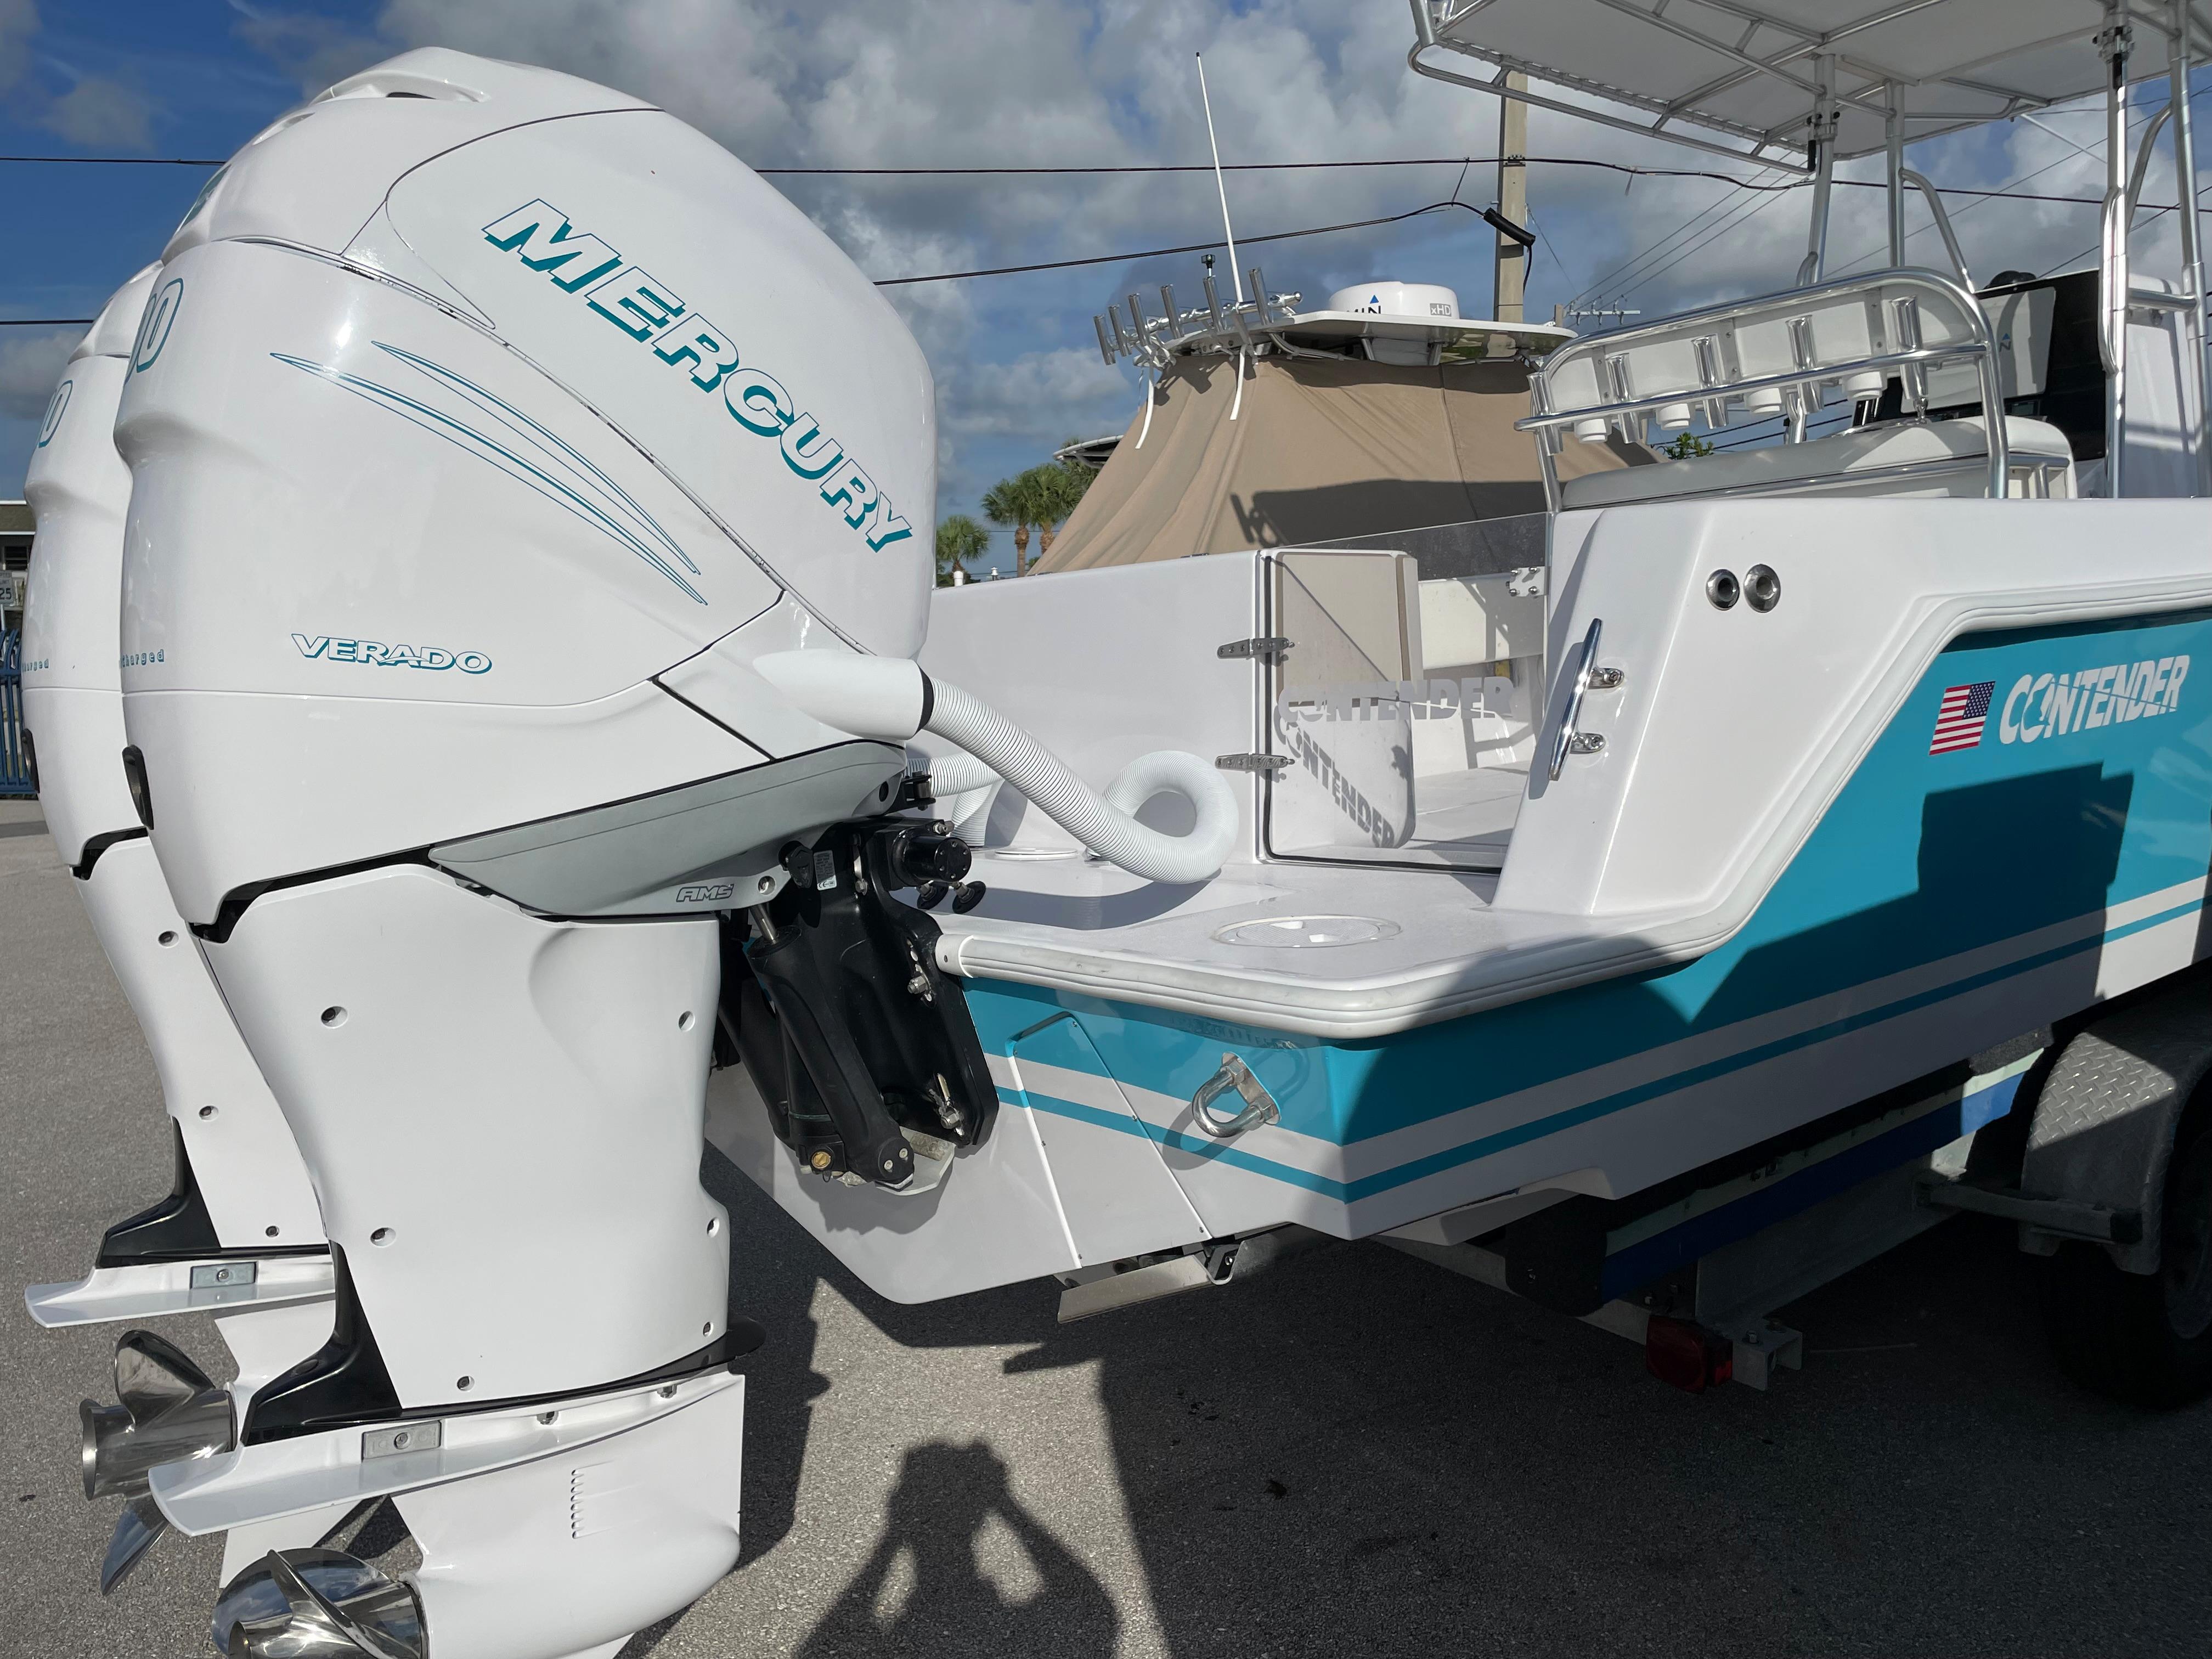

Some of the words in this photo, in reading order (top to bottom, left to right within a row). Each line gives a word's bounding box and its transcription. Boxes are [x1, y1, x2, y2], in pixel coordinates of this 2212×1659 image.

[1431, 304, 1452, 315] xHD
[481, 199, 913, 553] MERCURY
[0, 588, 12, 600] 25
[291, 633, 493, 675] VERADO
[1278, 676, 1514, 722] CONTENDER
[1999, 654, 2190, 744] CONTENDER
[676, 883, 735, 902] AMS
